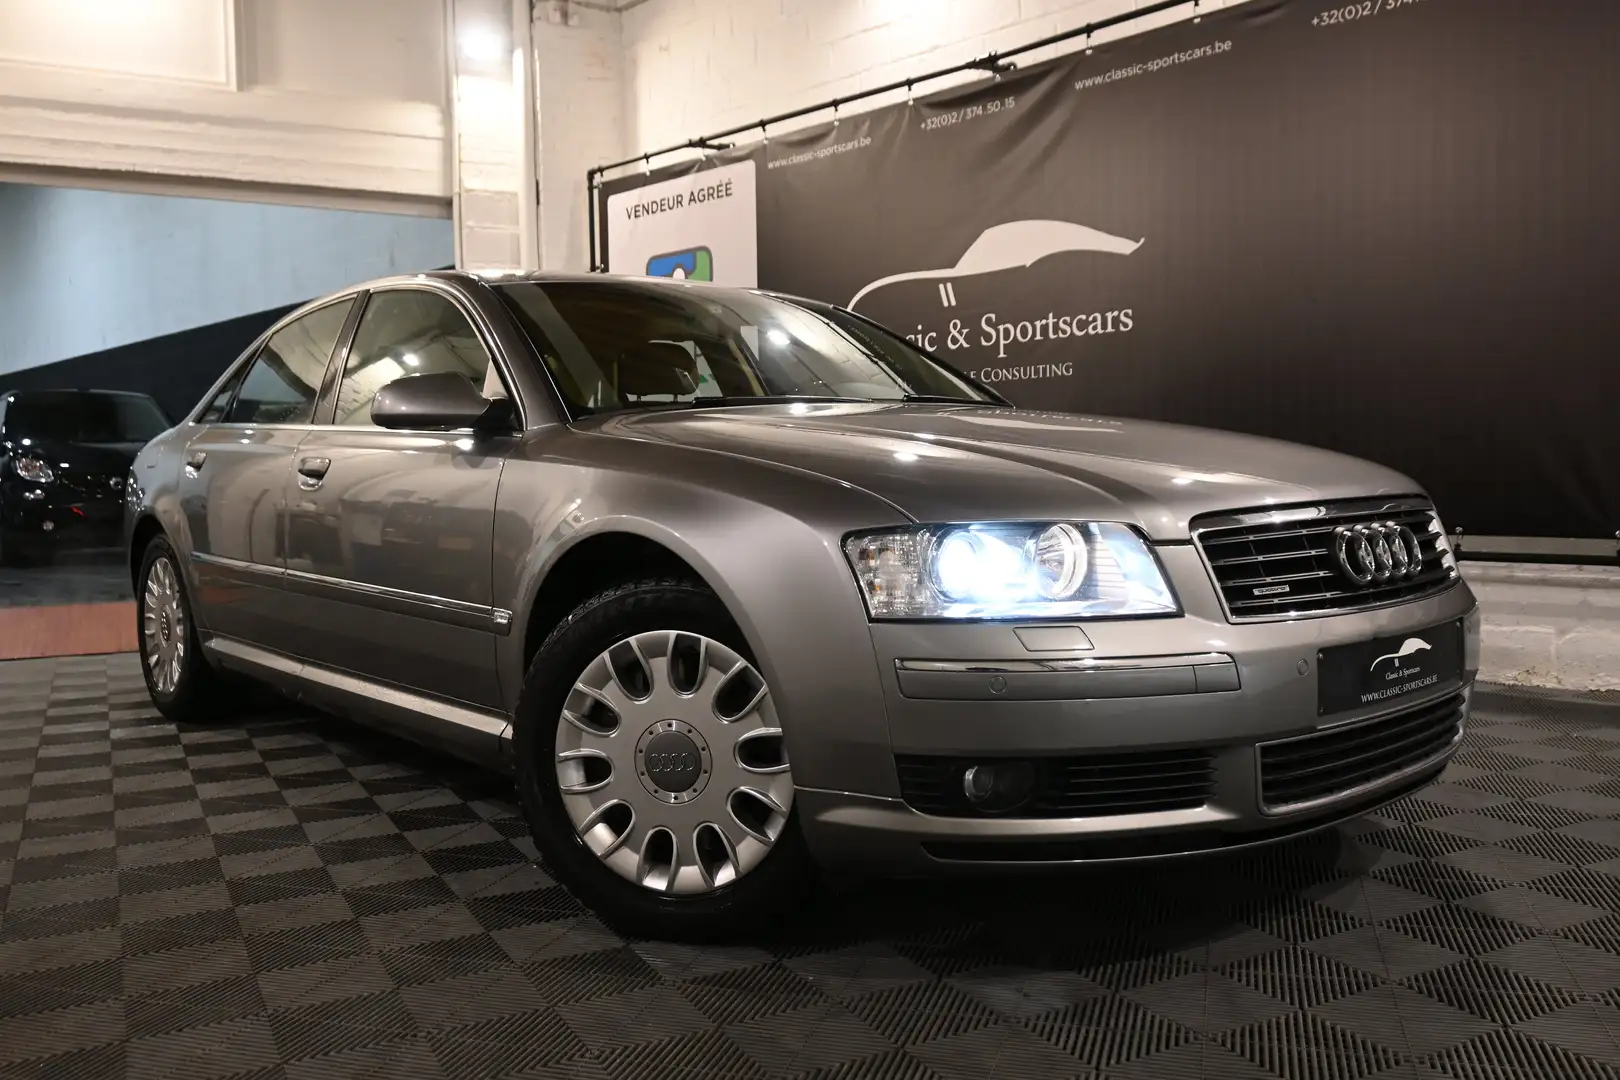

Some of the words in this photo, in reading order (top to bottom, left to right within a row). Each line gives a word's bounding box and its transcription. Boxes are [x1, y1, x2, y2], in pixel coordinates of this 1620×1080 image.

[1074, 40, 1233, 91] www.classic-sportscars.be
[767, 136, 872, 169] www.classic-sportscars.be
[626, 194, 684, 220] VENDEUR
[688, 178, 733, 206] AGRÉÉ
[947, 319, 971, 350] &
[980, 308, 1134, 358] Sportscars
[981, 362, 1074, 383] CONSULTING
[1361, 673, 1438, 703] WWW.CLASSIC-SPORTSCARS.BE
